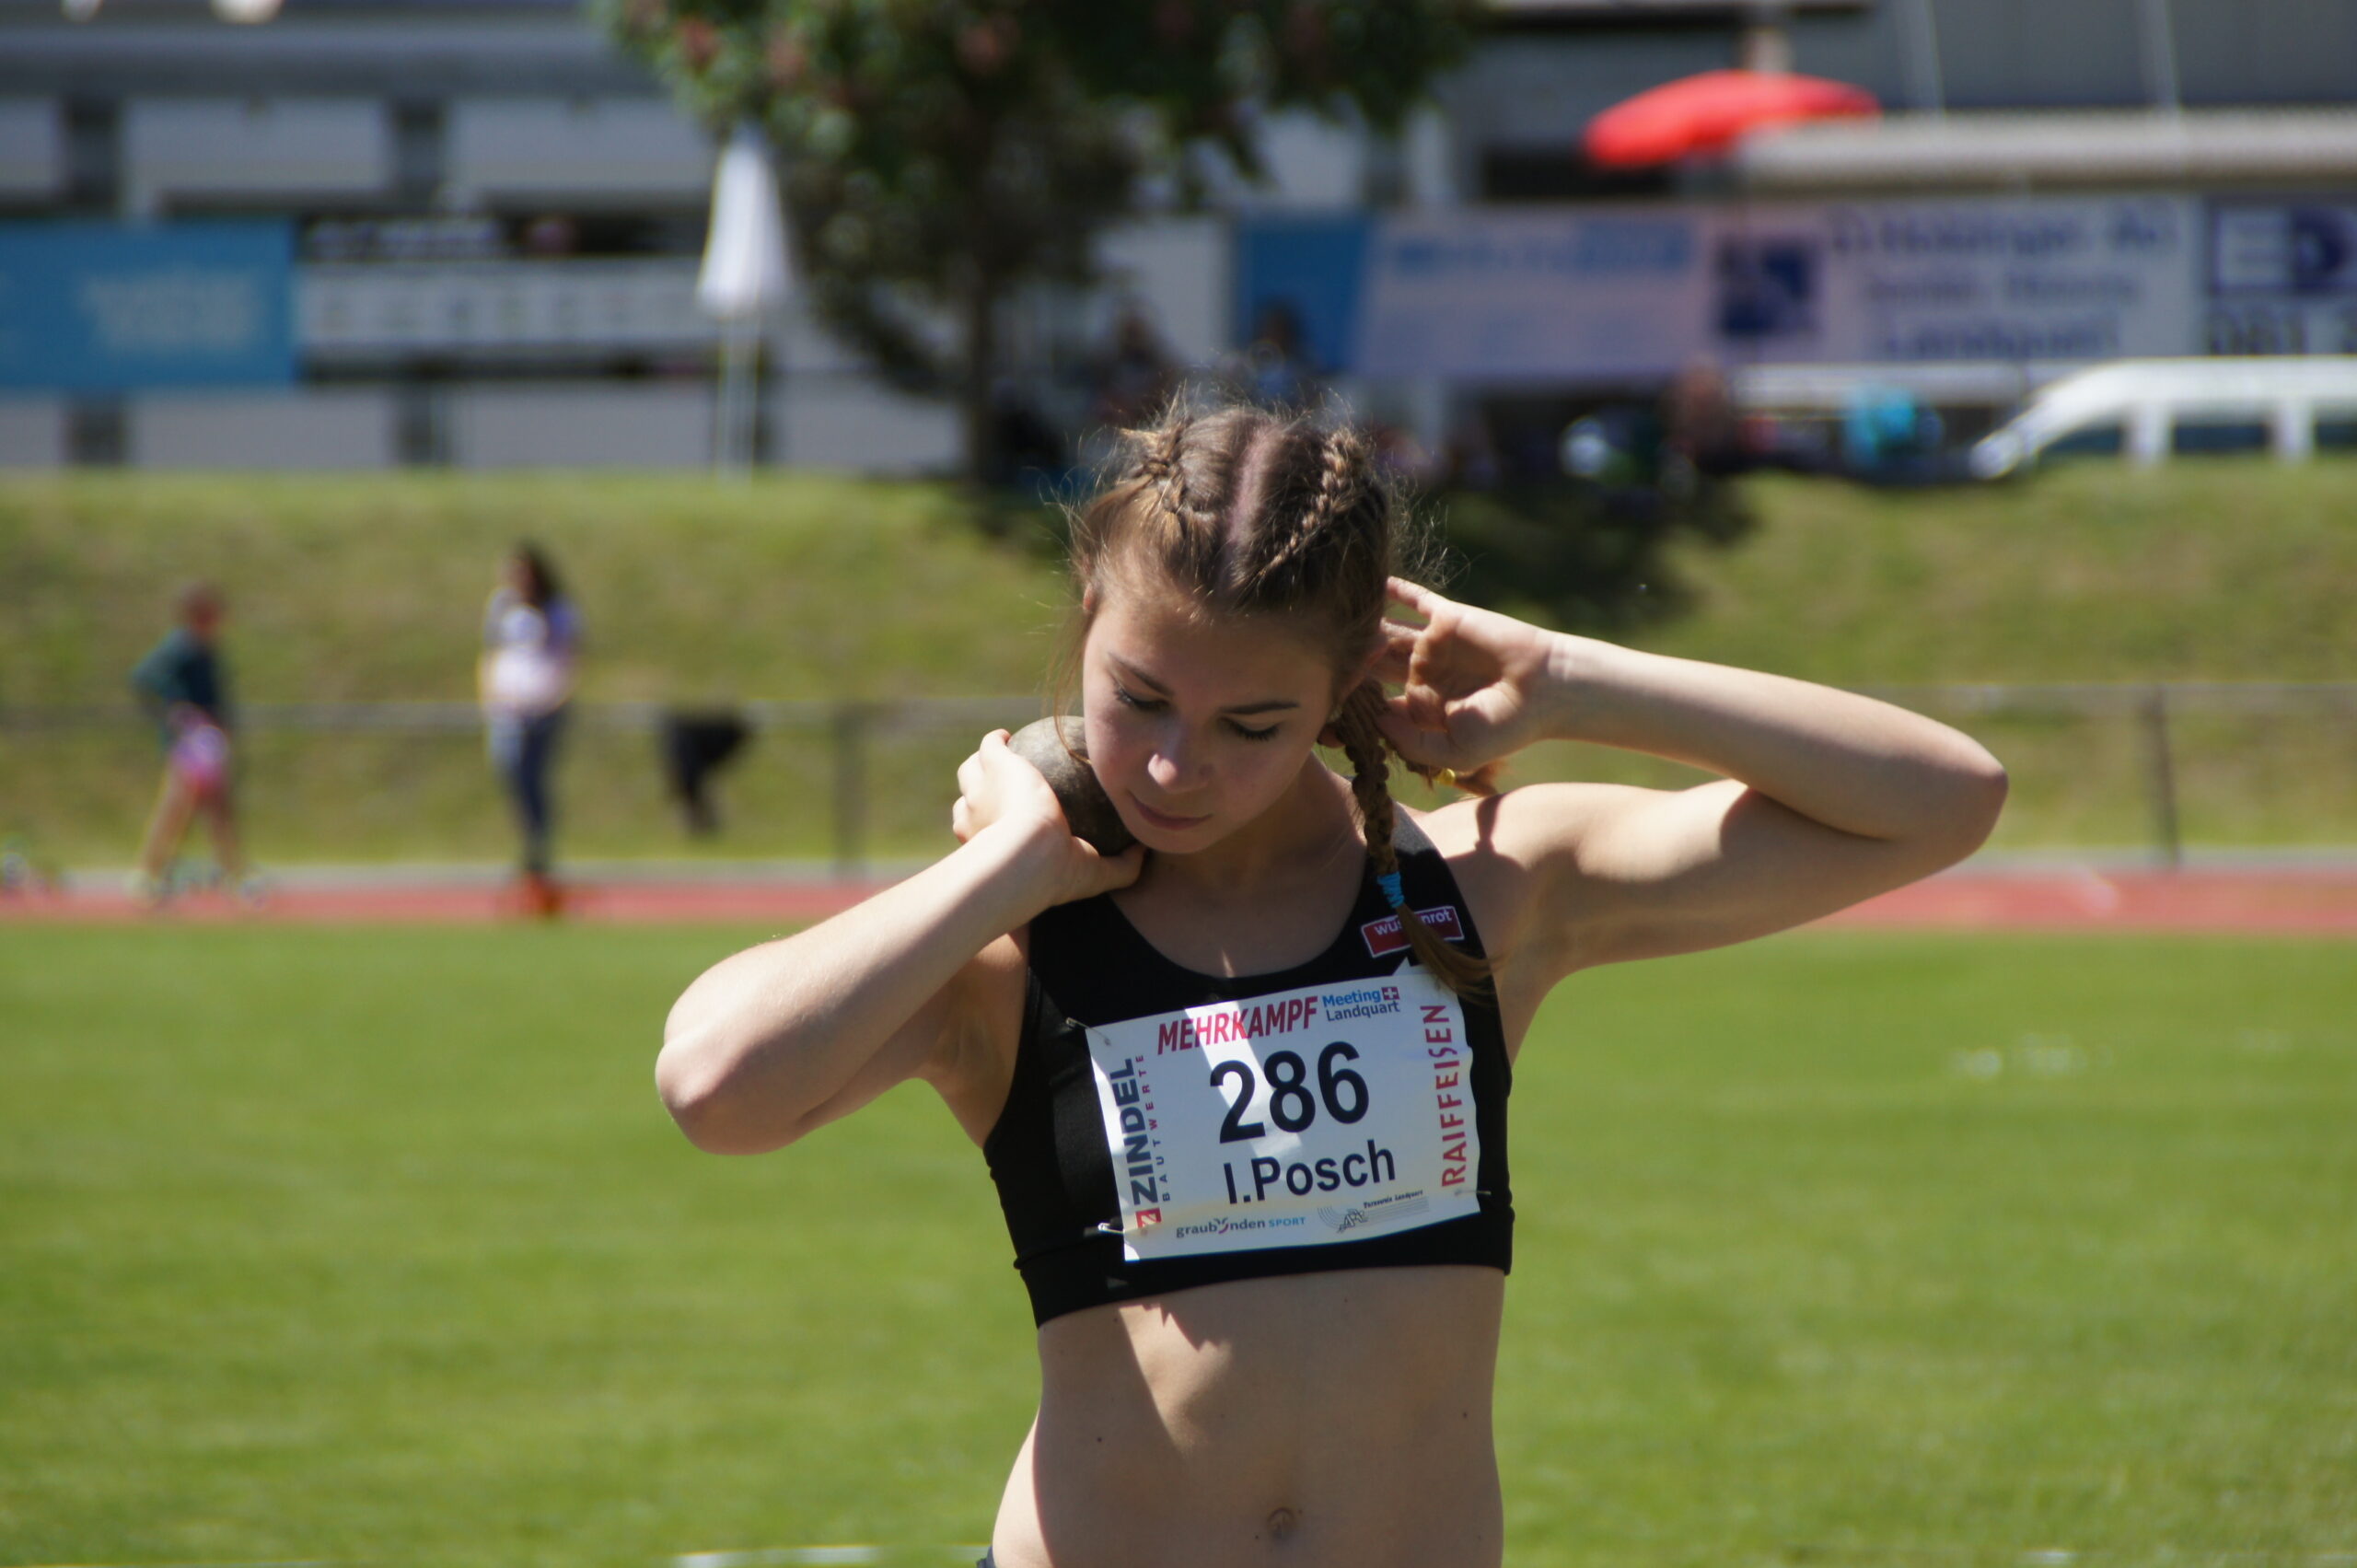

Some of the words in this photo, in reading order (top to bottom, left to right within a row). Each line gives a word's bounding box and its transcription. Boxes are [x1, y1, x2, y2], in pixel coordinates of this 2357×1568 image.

[1157, 996, 1318, 1055] MEHRKAMPF
[1322, 989, 1382, 1008] Meeting
[1327, 1001, 1400, 1022] Landquart
[1210, 1041, 1369, 1144] 286
[1420, 1005, 1467, 1187] RAIFFEISEN
[1109, 1059, 1158, 1205] ZINDEL
[1224, 1139, 1396, 1204] I.Posch
[1269, 1216, 1306, 1228] SPORT
